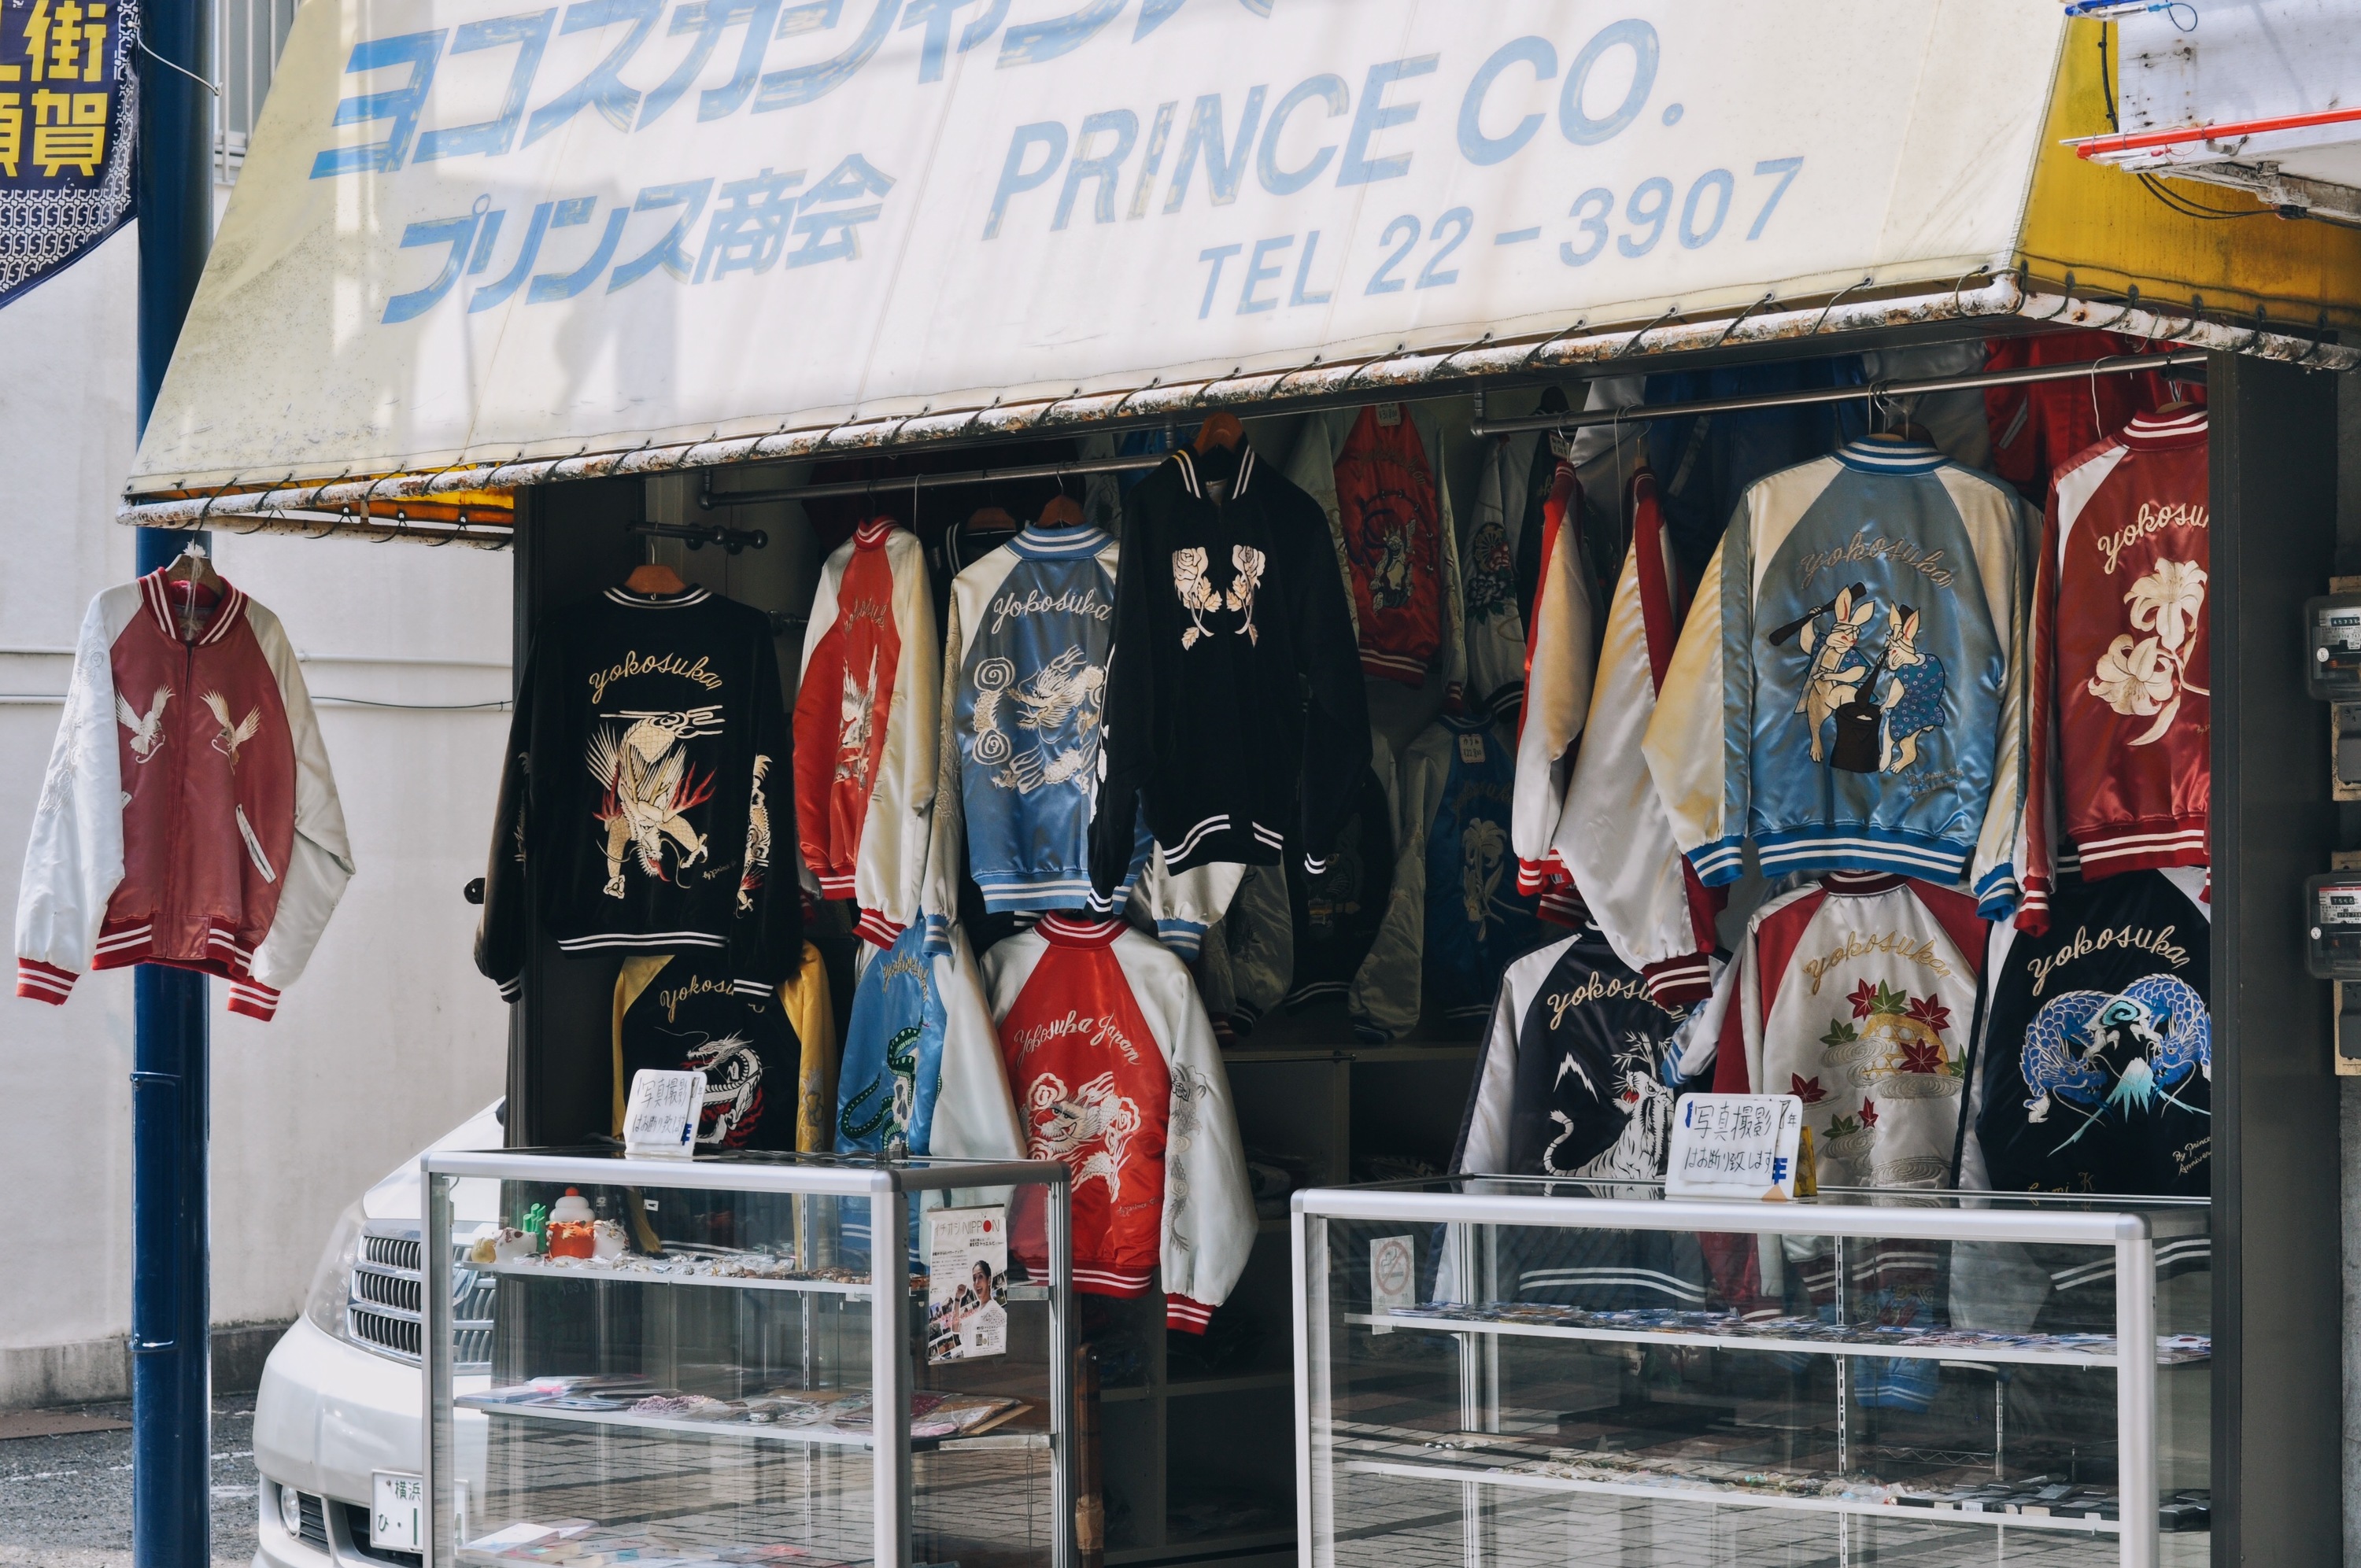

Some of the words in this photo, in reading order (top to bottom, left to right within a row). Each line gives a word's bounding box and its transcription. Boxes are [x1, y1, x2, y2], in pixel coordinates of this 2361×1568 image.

[982, 52, 1440, 240] PRINCE
[1458, 18, 1684, 166] CO.
[382, 153, 897, 325] プリンス商会
[1198, 230, 1332, 319] TEL
[641, 1076, 688, 1109] 写真撮影
[1694, 1101, 1772, 1142] 写真撮影
[1684, 1146, 1773, 1175] はお断り致します
[395, 1479, 422, 1502] 横浜
[378, 1513, 389, 1533] ひ
